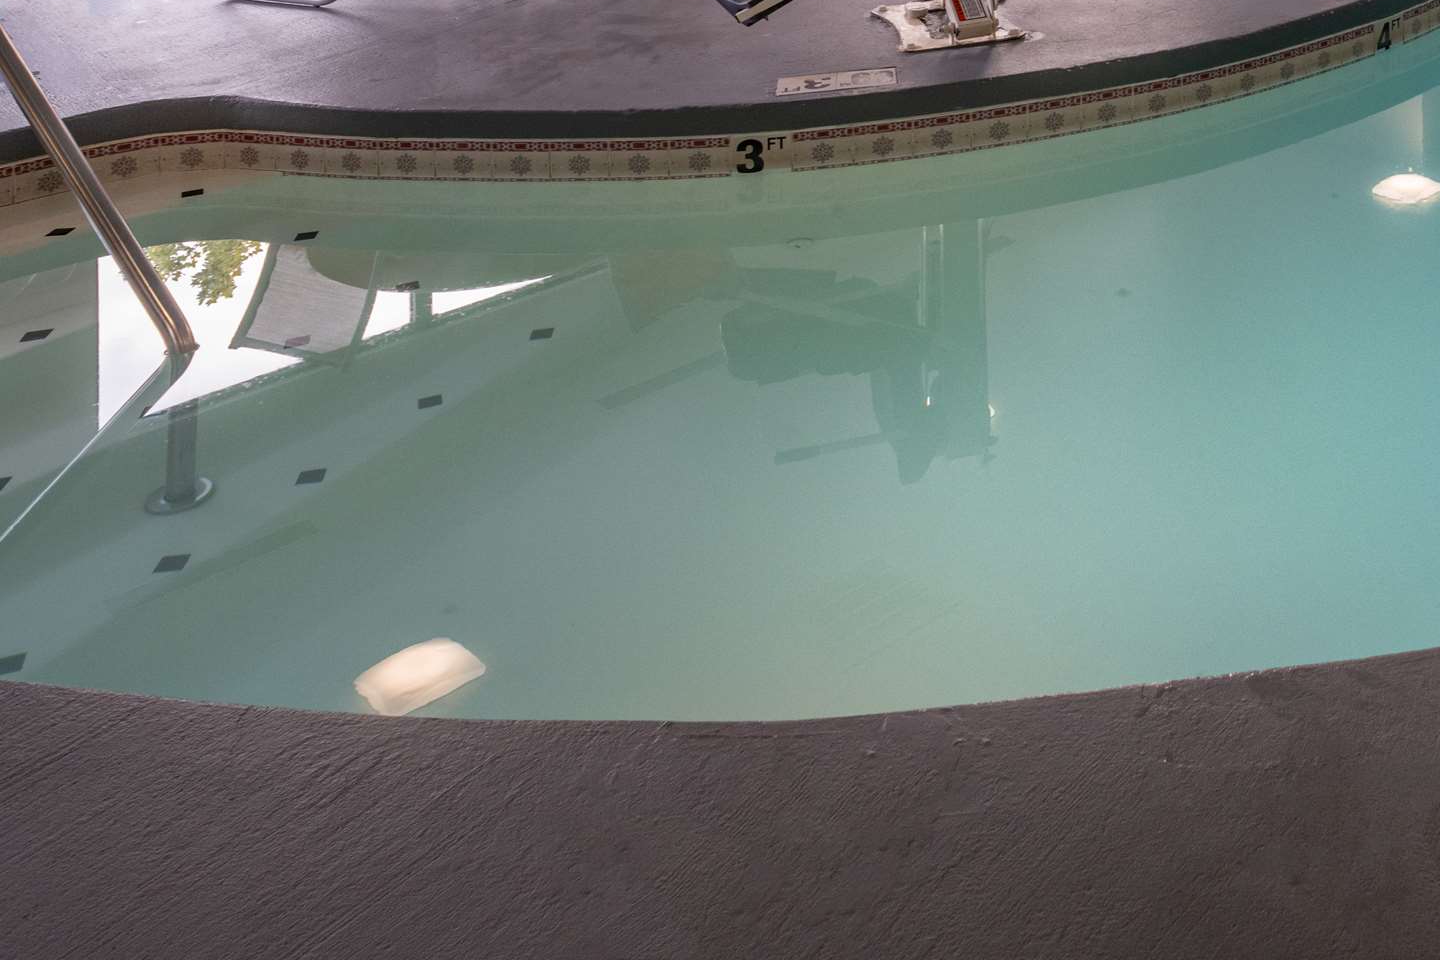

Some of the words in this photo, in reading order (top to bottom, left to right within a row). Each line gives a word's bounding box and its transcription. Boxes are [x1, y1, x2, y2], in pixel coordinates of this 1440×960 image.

[1377, 22, 1392, 50] 4
[1392, 17, 1401, 31] FT
[736, 138, 765, 173] 3
[767, 136, 787, 150] FT
